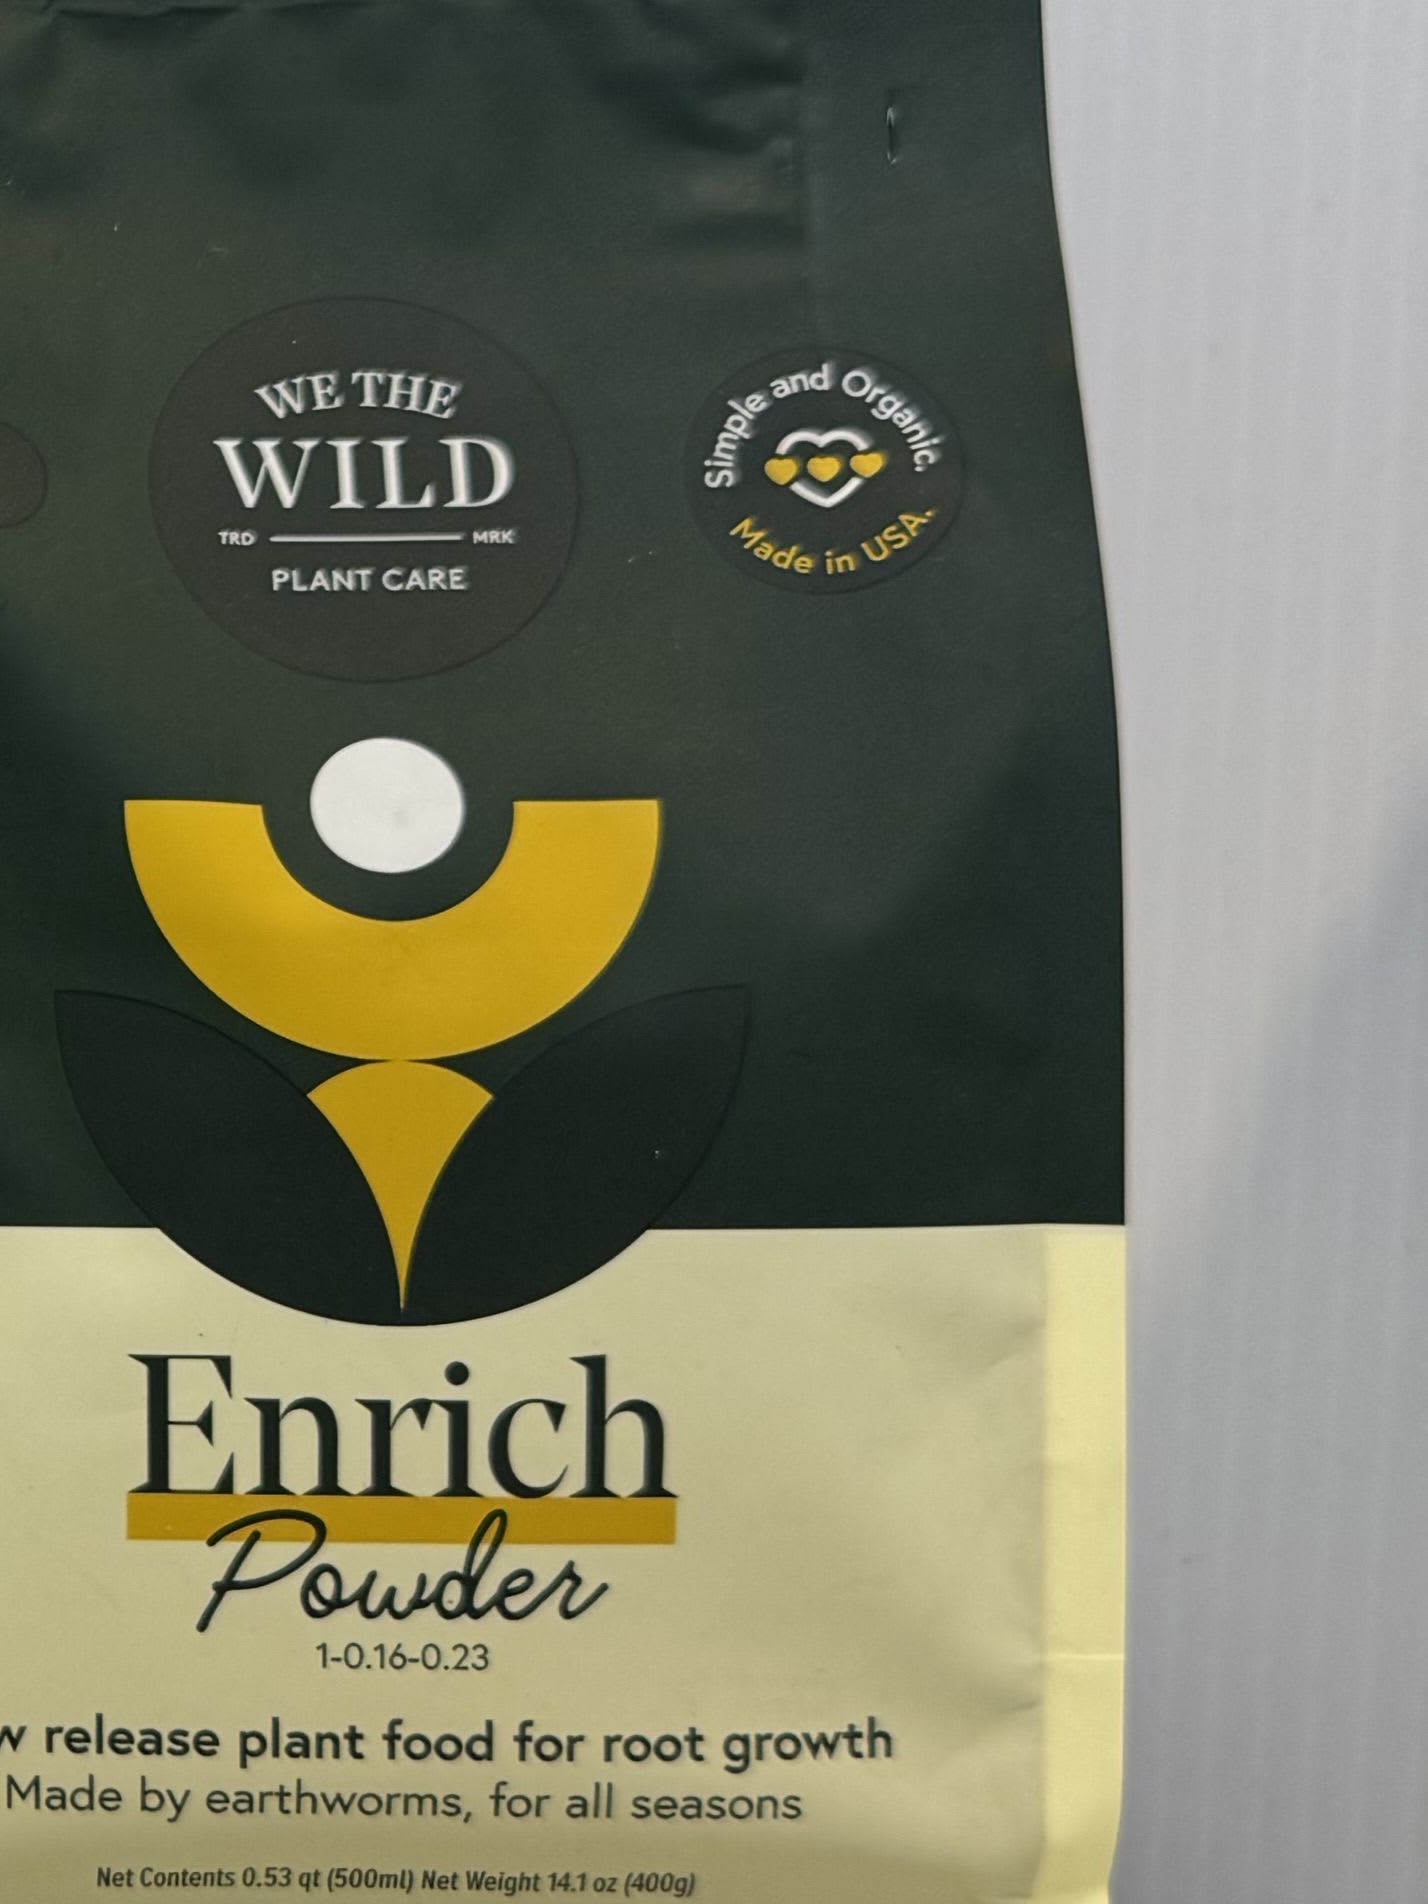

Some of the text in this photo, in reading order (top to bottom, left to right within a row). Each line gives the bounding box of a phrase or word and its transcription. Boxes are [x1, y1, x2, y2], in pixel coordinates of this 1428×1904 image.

[254, 368, 461, 419] WE THE
[704, 362, 940, 488] Simple and Organic.
[212, 436, 515, 509] WILD
[218, 528, 517, 546] TRD MRK
[729, 508, 936, 574] Made in USA.
[272, 566, 468, 591] PLANT CARE
[127, 1353, 679, 1499] Enrich
[196, 1508, 609, 1632] Powder
[316, 1642, 490, 1670] 1-0.16-0.23
[45, 1713, 220, 1756] release
[240, 1716, 365, 1768] plant
[382, 1718, 494, 1762] food
[513, 1719, 584, 1763] for
[603, 1726, 705, 1763] root
[723, 1716, 894, 1774] growth
[6, 1774, 803, 1824] Made by earthworms, for all seasons
[97, 1867, 696, 1897] Net Contents 0.53 qt (500ml) Net Weight 14.1 oz (400g)
